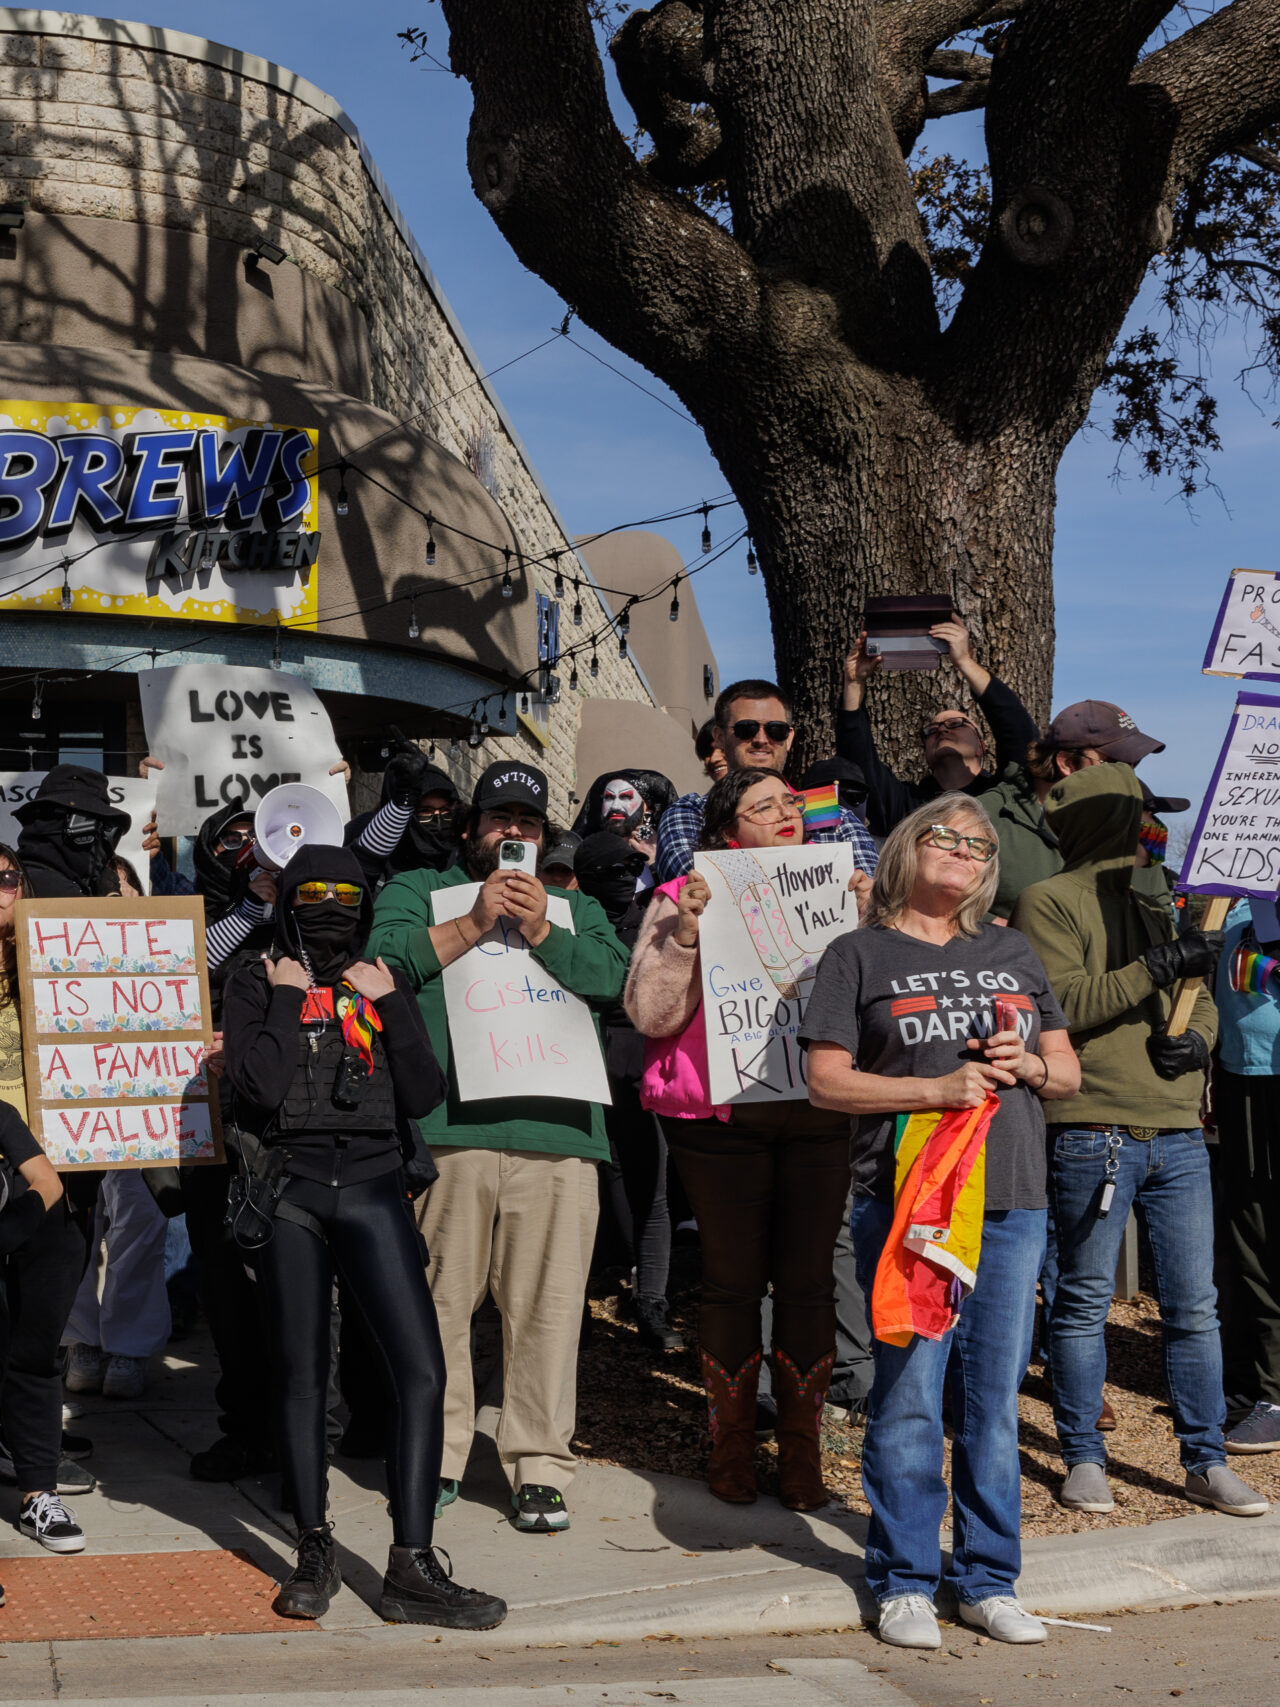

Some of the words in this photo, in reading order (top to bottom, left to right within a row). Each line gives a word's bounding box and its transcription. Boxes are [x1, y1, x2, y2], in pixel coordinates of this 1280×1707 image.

[147, 531, 321, 580] KITCHEN
[1242, 714, 1280, 730] DRA
[231, 734, 263, 759] IS
[493, 771, 541, 795] DALLAS
[1203, 831, 1228, 841] ONE
[1212, 814, 1259, 828] YOU'RE
[1196, 846, 1280, 882] KIDS.
[794, 890, 846, 935] Y'ALL!
[34, 920, 172, 957] HATE
[48, 980, 89, 1016] IS
[112, 979, 189, 1014] NOT
[890, 969, 971, 994] LET'S
[976, 970, 1020, 991] GO
[730, 1034, 741, 1045] A
[744, 1030, 762, 1042] BIG
[898, 1010, 1032, 1046] DARWN
[46, 1046, 72, 1080] A
[93, 1043, 204, 1081] FAMILY
[59, 1105, 196, 1145] VALUE
